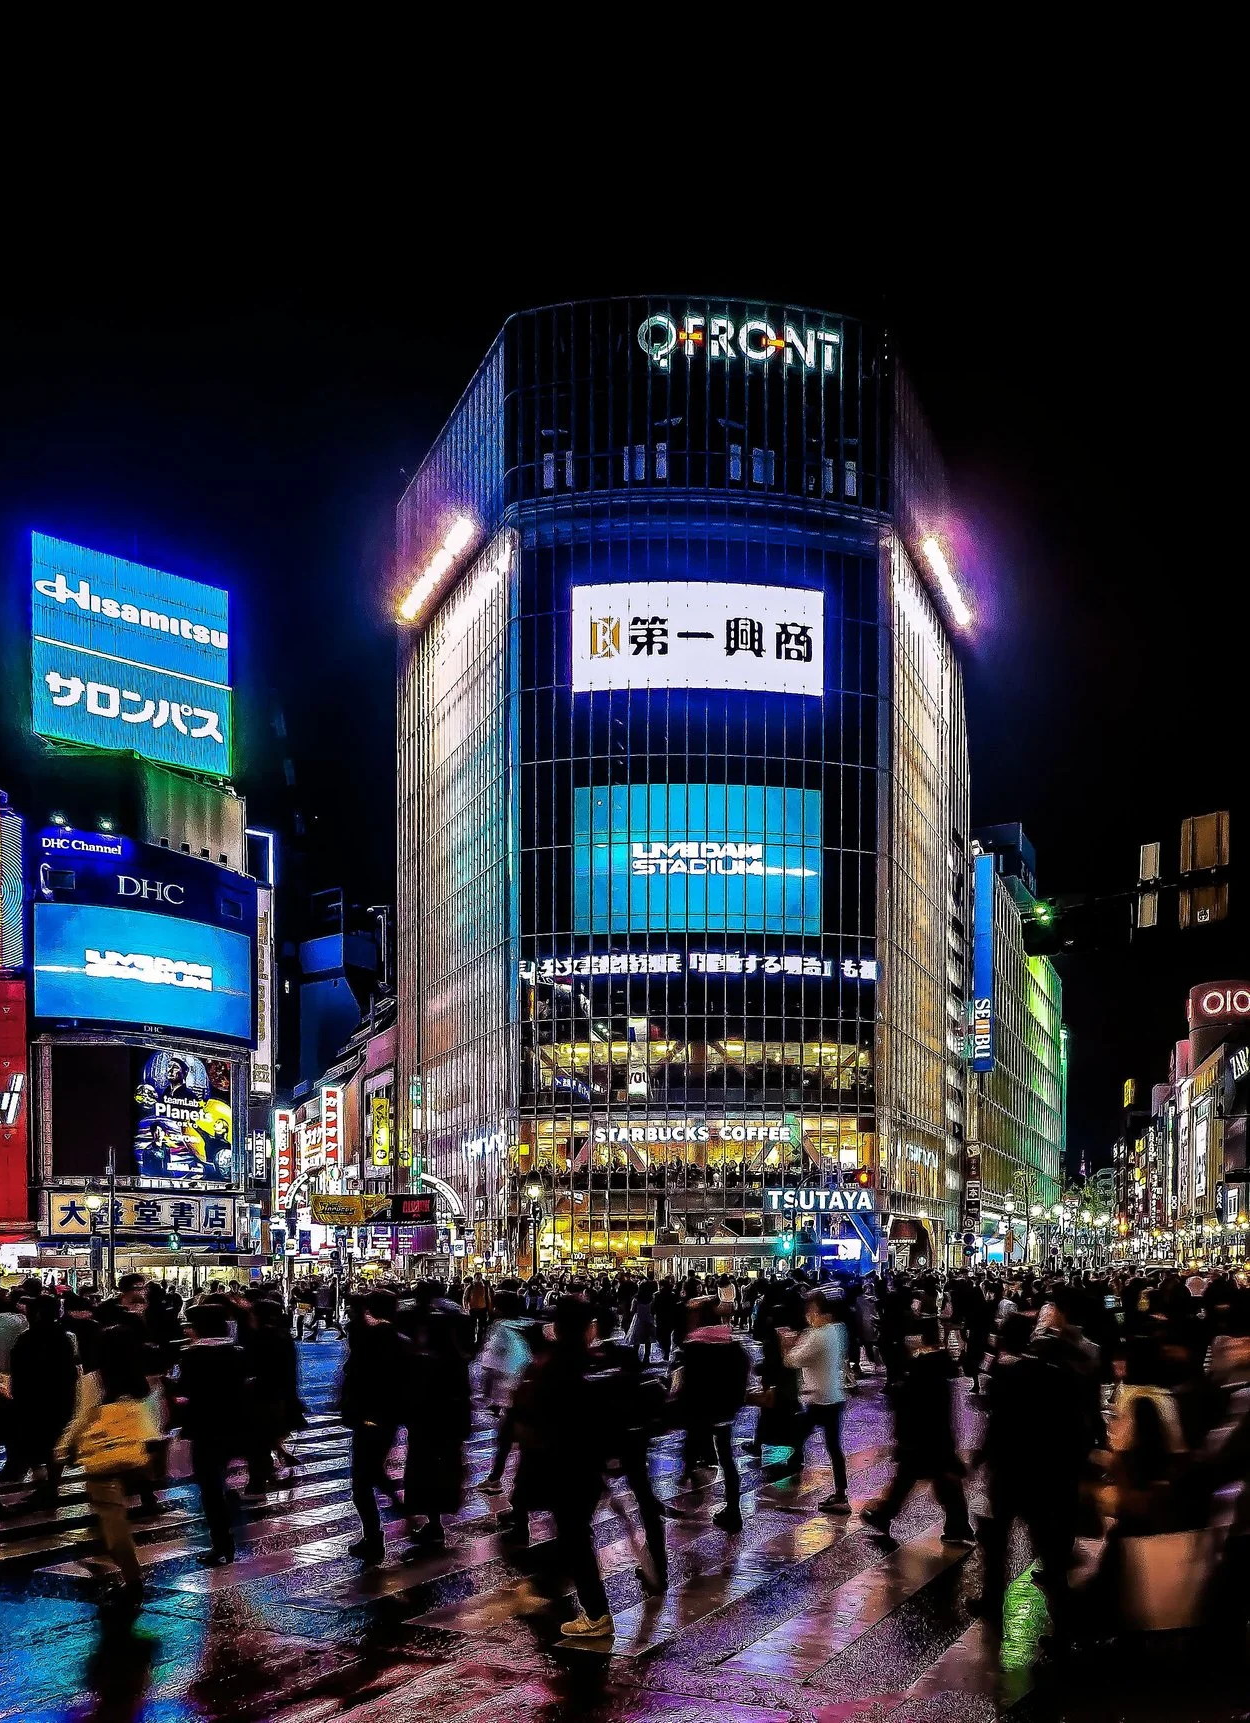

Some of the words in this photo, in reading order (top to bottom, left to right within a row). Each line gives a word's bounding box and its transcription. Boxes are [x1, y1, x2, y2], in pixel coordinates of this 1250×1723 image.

[637, 313, 841, 373] QFRONT
[34, 573, 228, 649] Hisamitsu
[629, 616, 814, 663] 第一興商
[44, 671, 224, 744] サロンパス
[41, 837, 70, 849] DHC
[71, 839, 122, 856] Channel
[631, 858, 763, 876] STADIUM
[116, 874, 185, 905] DHC
[143, 1025, 164, 1034] DHC
[974, 998, 991, 1059] SEIBU
[155, 1102, 214, 1123] Planets
[163, 1095, 200, 1107] teamLab
[594, 1125, 710, 1143] STARBUCKS
[718, 1126, 791, 1142] COFFEE
[767, 1190, 873, 1210] TSUTAYA
[1216, 1184, 1224, 1209] ZARA
